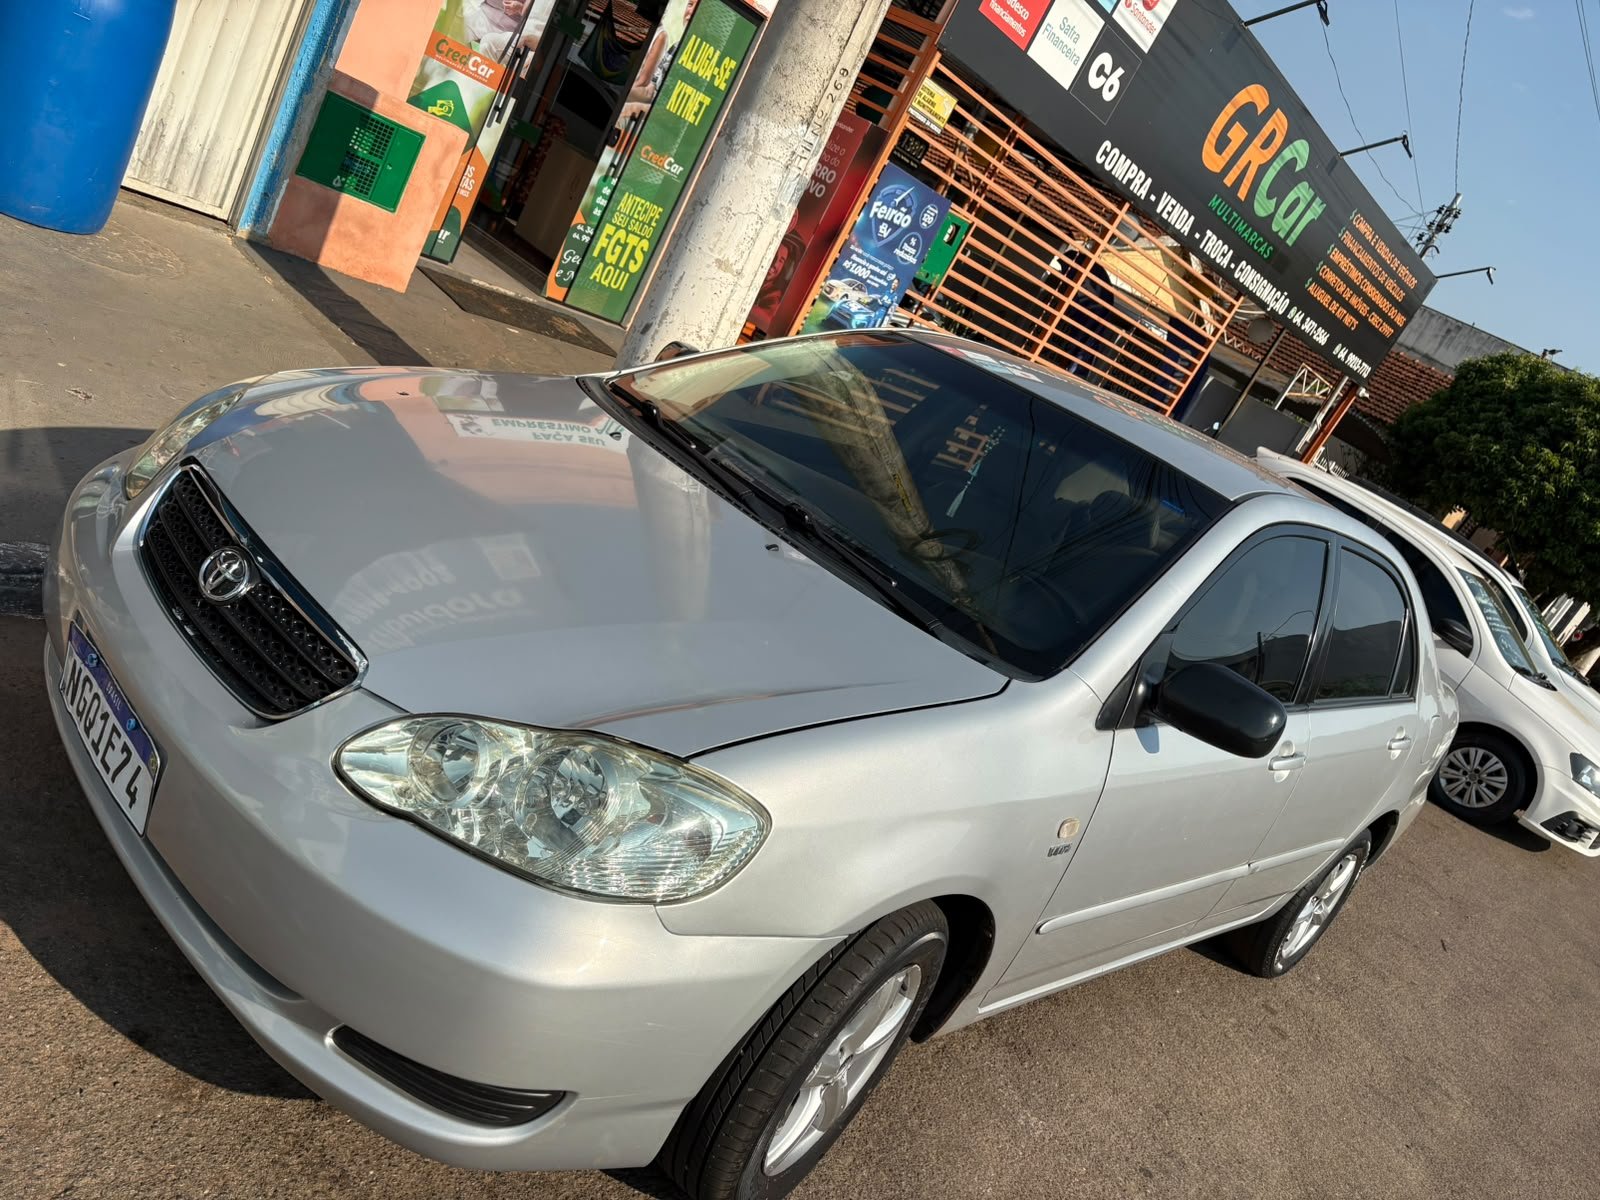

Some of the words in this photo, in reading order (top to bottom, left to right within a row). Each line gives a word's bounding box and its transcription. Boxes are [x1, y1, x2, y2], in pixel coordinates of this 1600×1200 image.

[1042, 22, 1080, 67] Financeira
[1059, 16, 1080, 44] Safra
[435, 38, 495, 79] CredCar
[677, 34, 737, 91] ALUGA-SE
[1088, 52, 1125, 102] C6
[666, 80, 711, 126] KITNET
[640, 145, 684, 175] CredCar
[612, 212, 627, 229] SEU
[627, 219, 654, 239] SALDO
[617, 192, 663, 227] ANTECIPE
[869, 200, 912, 229] Feirão
[1095, 139, 1153, 201] COMPRA
[1155, 191, 1195, 236] VENDA
[1199, 229, 1234, 269] TROCA
[1233, 259, 1290, 316] CONSIGNAÇÃO
[1208, 193, 1273, 259] MULTIMARCAS
[592, 223, 649, 273] FGTS
[1340, 230, 1382, 276] FINANCIAMENTOS
[1352, 213, 1374, 242] COMPRA
[1375, 238, 1394, 265] VENDAS
[590, 262, 630, 291] AQUI
[1307, 282, 1332, 309] ALUGUEL
[1319, 265, 1345, 296] CORRETOR
[1329, 248, 1362, 285] EMPRÉSTIMOS
[1360, 279, 1390, 314] CONSIGNADOS
[65, 658, 142, 810] NGQ1E74
